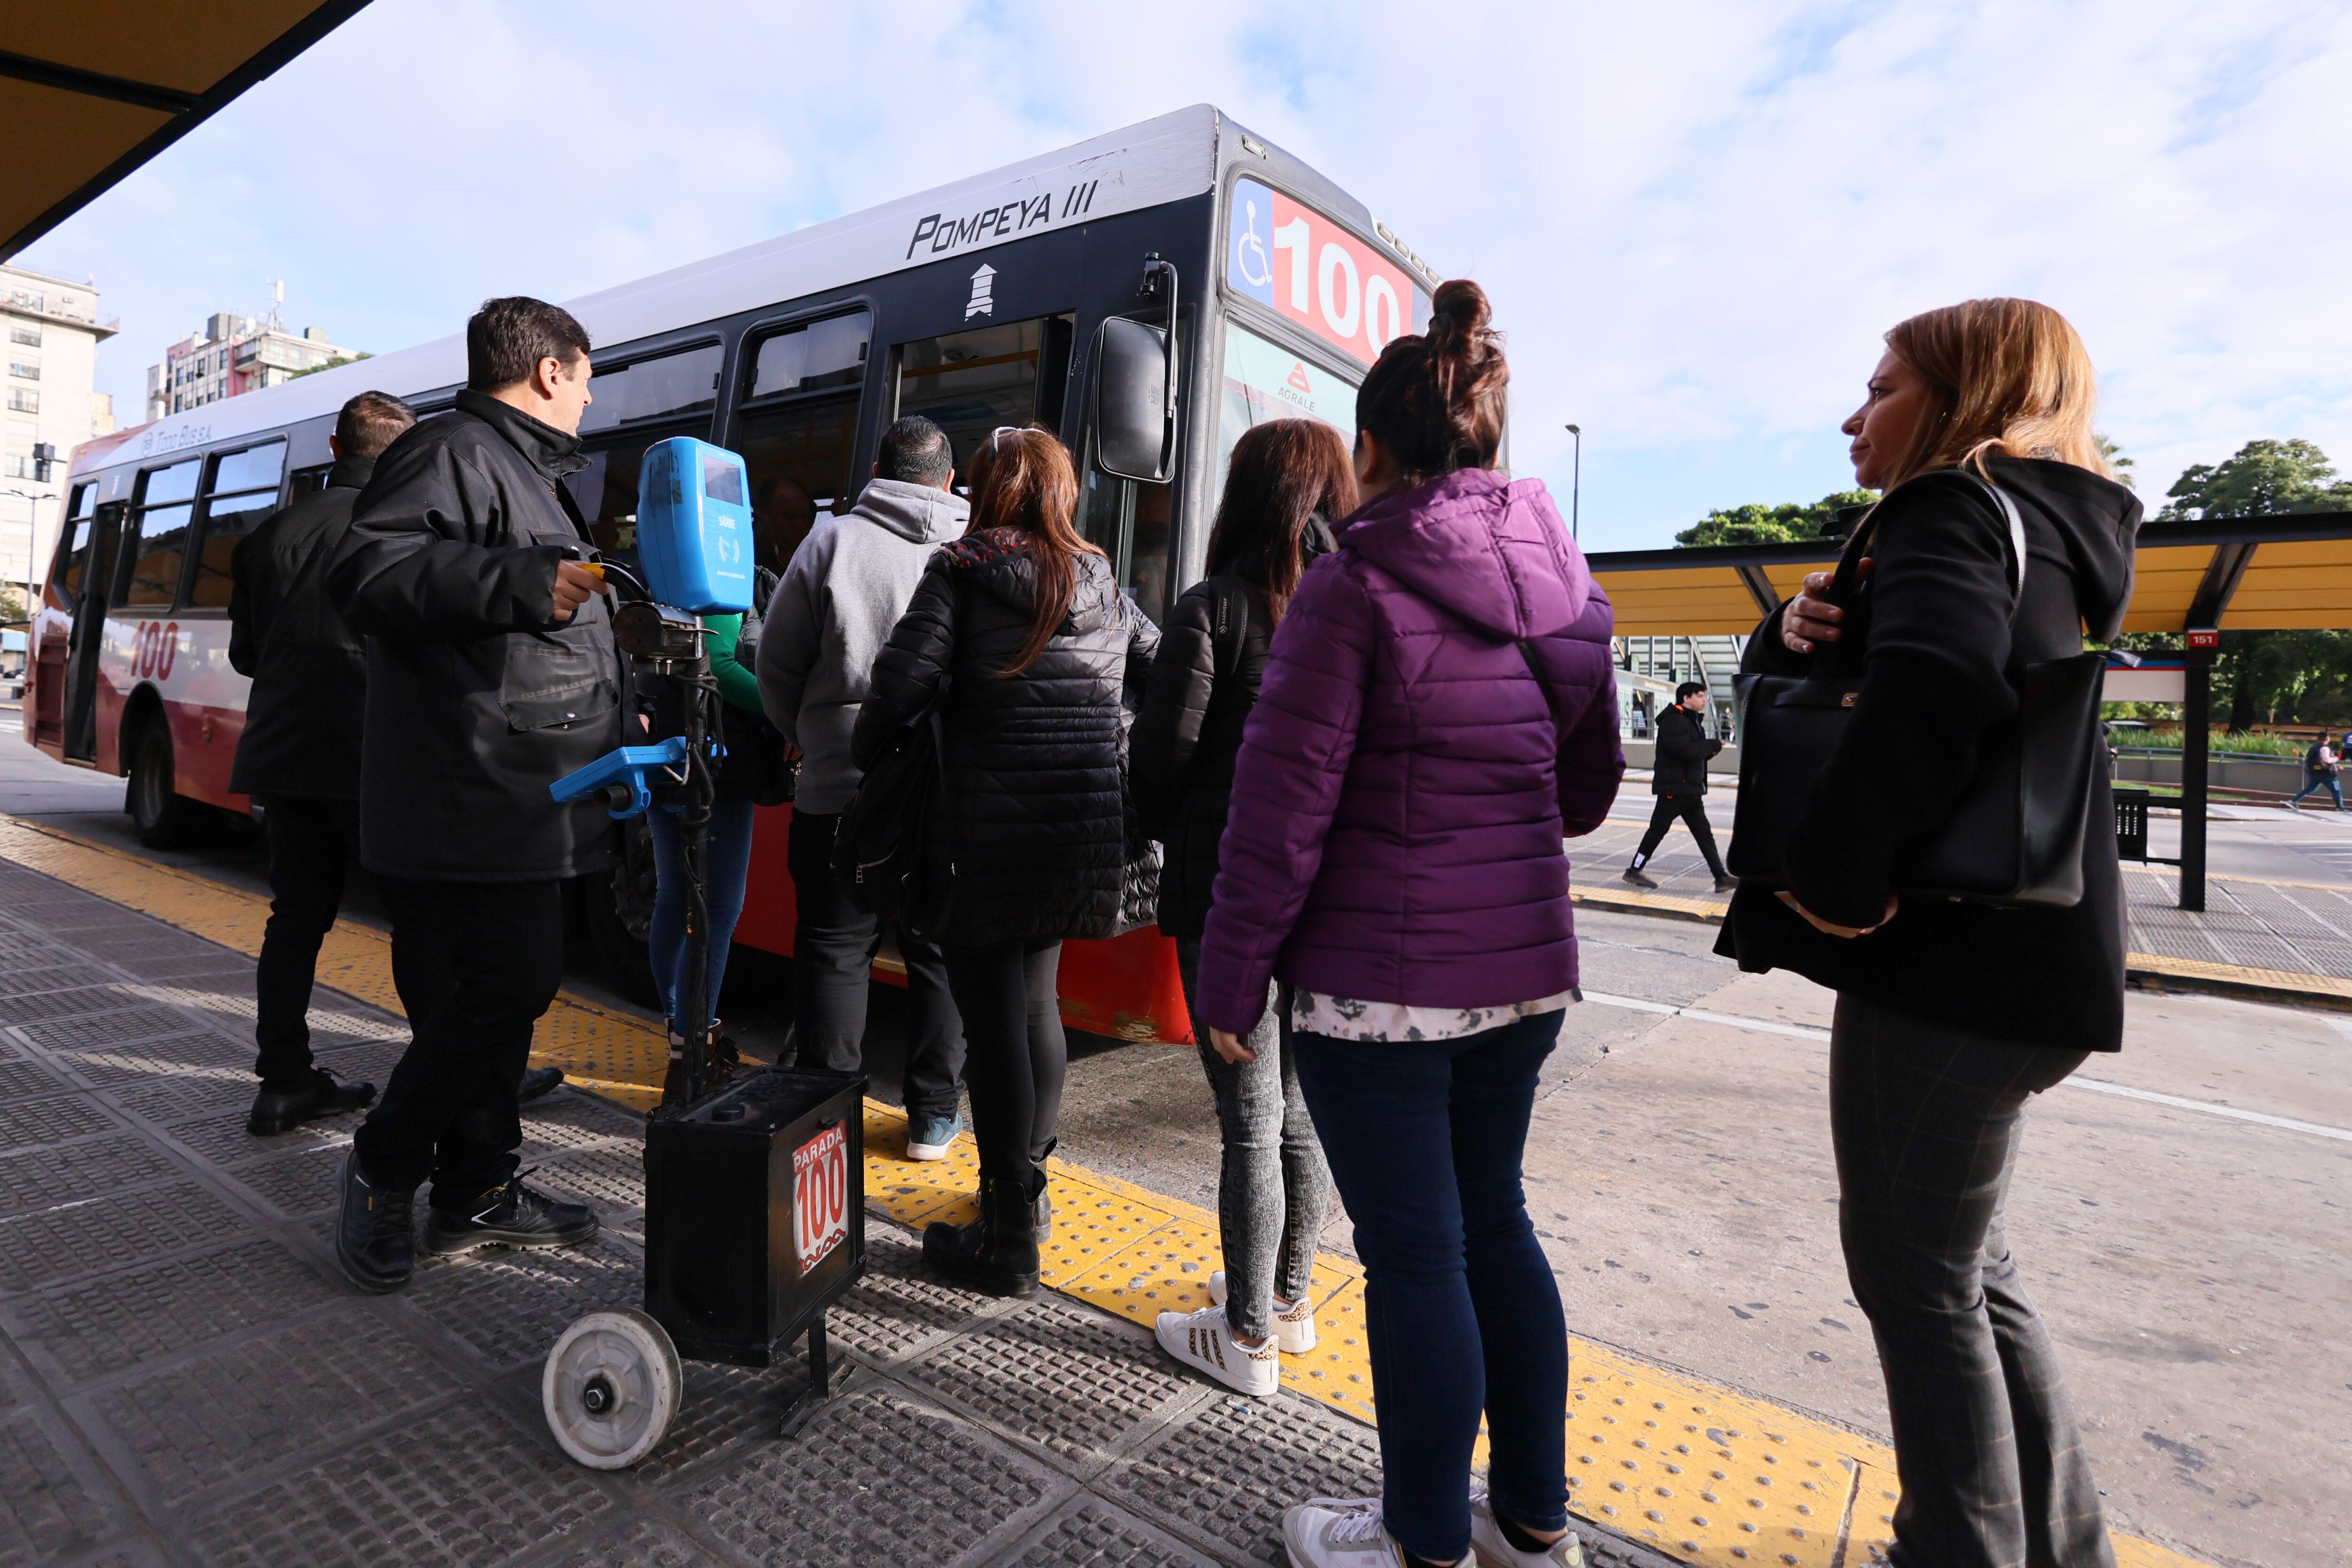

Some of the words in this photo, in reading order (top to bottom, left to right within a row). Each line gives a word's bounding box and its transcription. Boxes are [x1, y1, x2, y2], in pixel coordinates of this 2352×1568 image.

[906, 193, 1051, 260] POMPEYA
[1062, 179, 1099, 218] III
[1274, 216, 1400, 359] 100
[1278, 387, 1315, 412] AGRALE
[718, 515, 736, 530] SUBE
[131, 620, 179, 681] 100
[2193, 635, 2213, 644] 151
[793, 1127, 843, 1173] PARADA
[796, 1145, 844, 1250] 100
